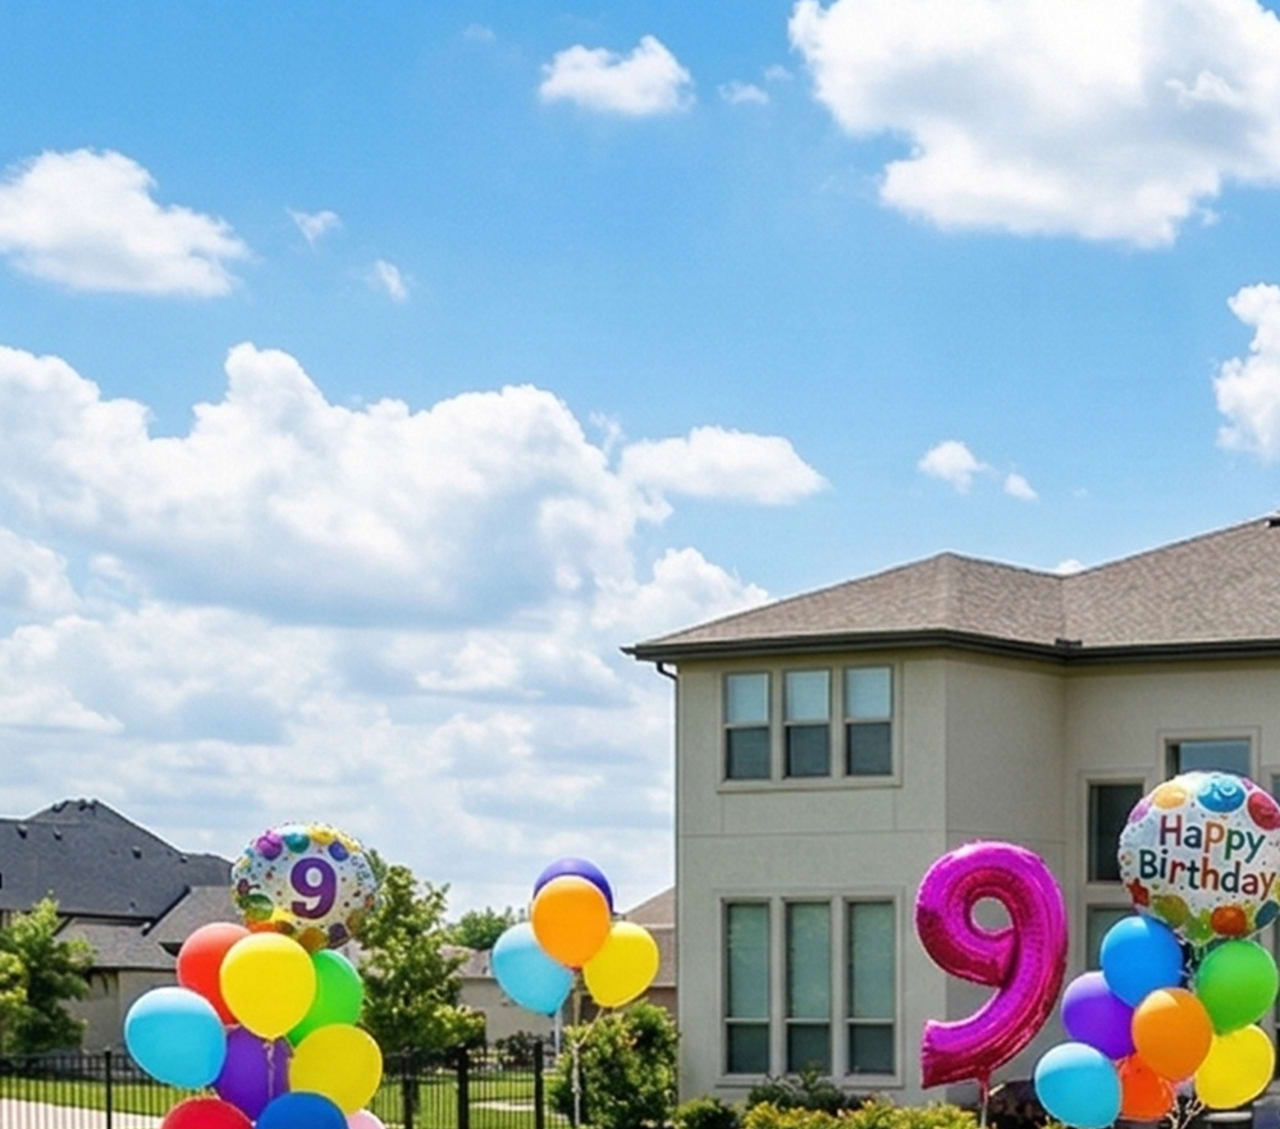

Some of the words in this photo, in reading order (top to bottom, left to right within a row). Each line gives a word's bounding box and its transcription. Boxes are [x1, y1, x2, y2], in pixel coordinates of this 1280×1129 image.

[1160, 814, 1266, 864] Happy
[290, 857, 337, 919] 9
[1139, 848, 1277, 901] Birthday
[915, 840, 1068, 1090] 9
